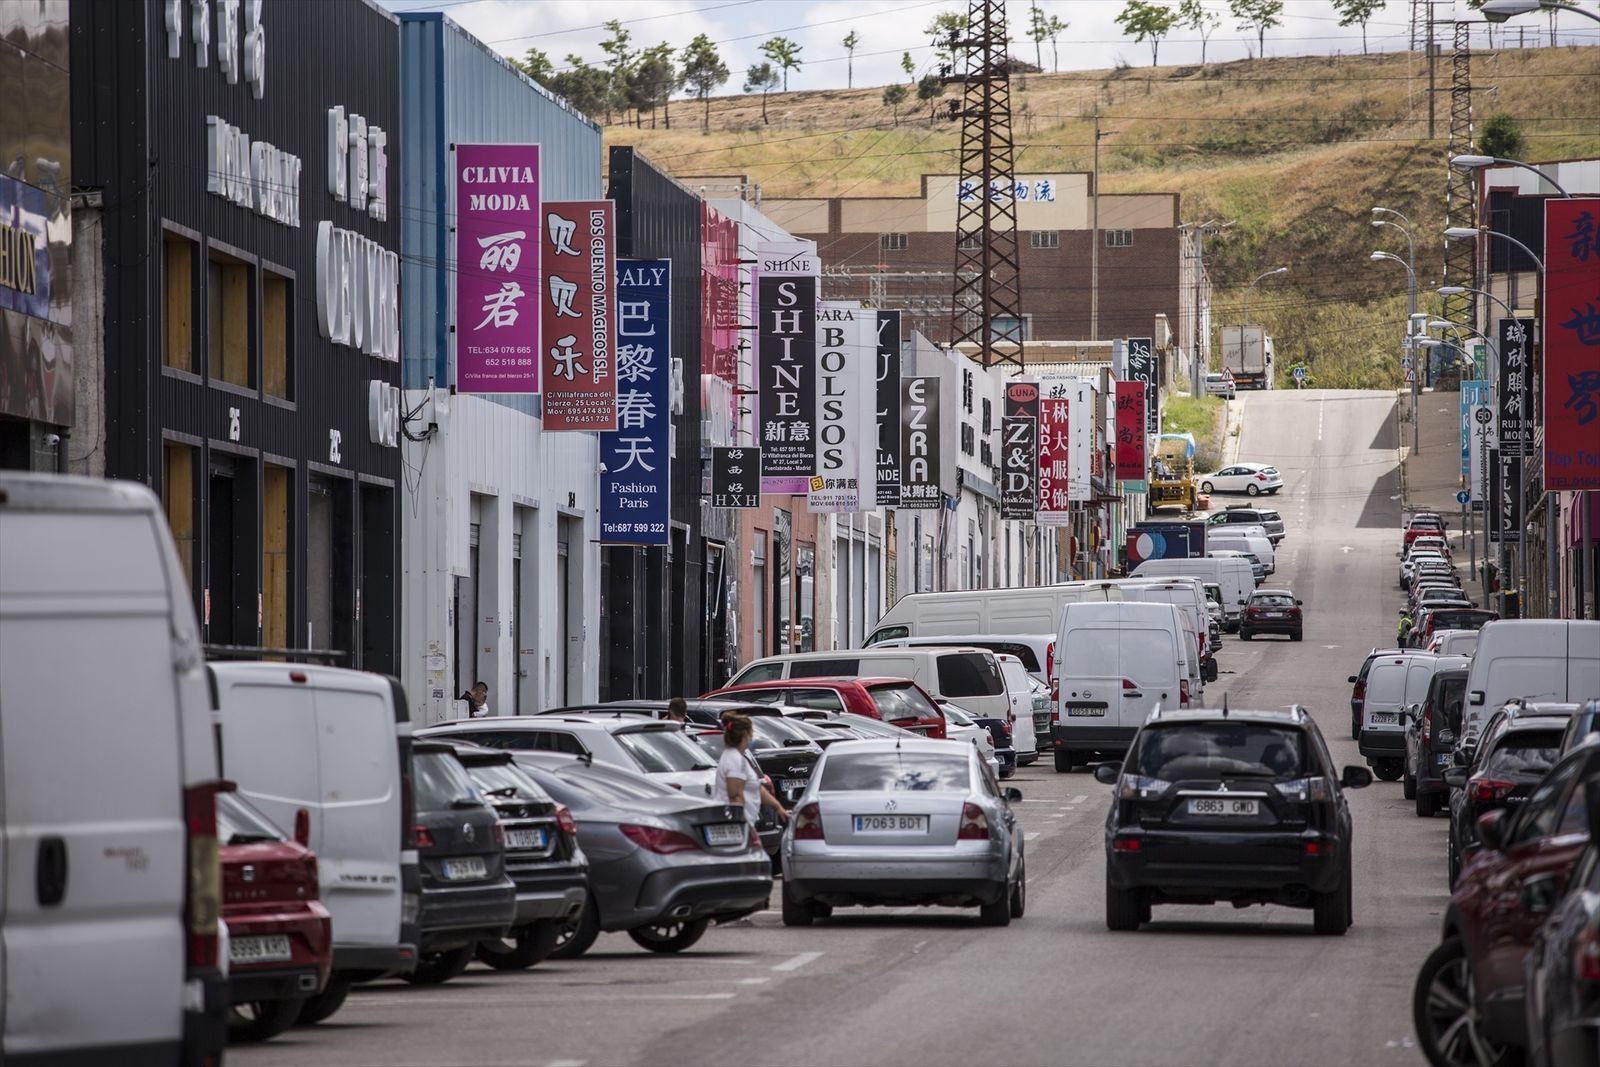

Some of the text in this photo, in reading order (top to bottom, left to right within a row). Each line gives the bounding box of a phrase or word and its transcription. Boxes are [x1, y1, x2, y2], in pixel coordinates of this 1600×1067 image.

[462, 167, 535, 184] CLIVIA
[470, 194, 530, 211] MODA
[590, 209, 605, 236] LOS
[591, 237, 606, 293] CUENTO
[764, 260, 810, 272] SHINE
[473, 230, 527, 331] 丽君
[616, 268, 666, 286] ALY
[592, 294, 608, 357] MAGICOS
[501, 346, 515, 354] 076
[517, 346, 531, 354] 665
[771, 282, 803, 416] SHINE
[485, 358, 500, 366] 652
[502, 358, 516, 366] 518
[613, 300, 657, 473] 巴黎春天
[1009, 389, 1036, 397] LUNA
[821, 327, 846, 470] BOLSOS
[764, 420, 810, 442] 新意
[1502, 419, 1517, 429] RUI
[1006, 423, 1030, 493] Z&D
[1039, 402, 1051, 510] LINDA MODA
[1052, 402, 1068, 510] 林大服饰
[611, 482, 657, 493] Fashion
[618, 497, 649, 508] Paris
[603, 523, 665, 533] Tel:687 599 322
[865, 817, 922, 829] 7063 BDT
